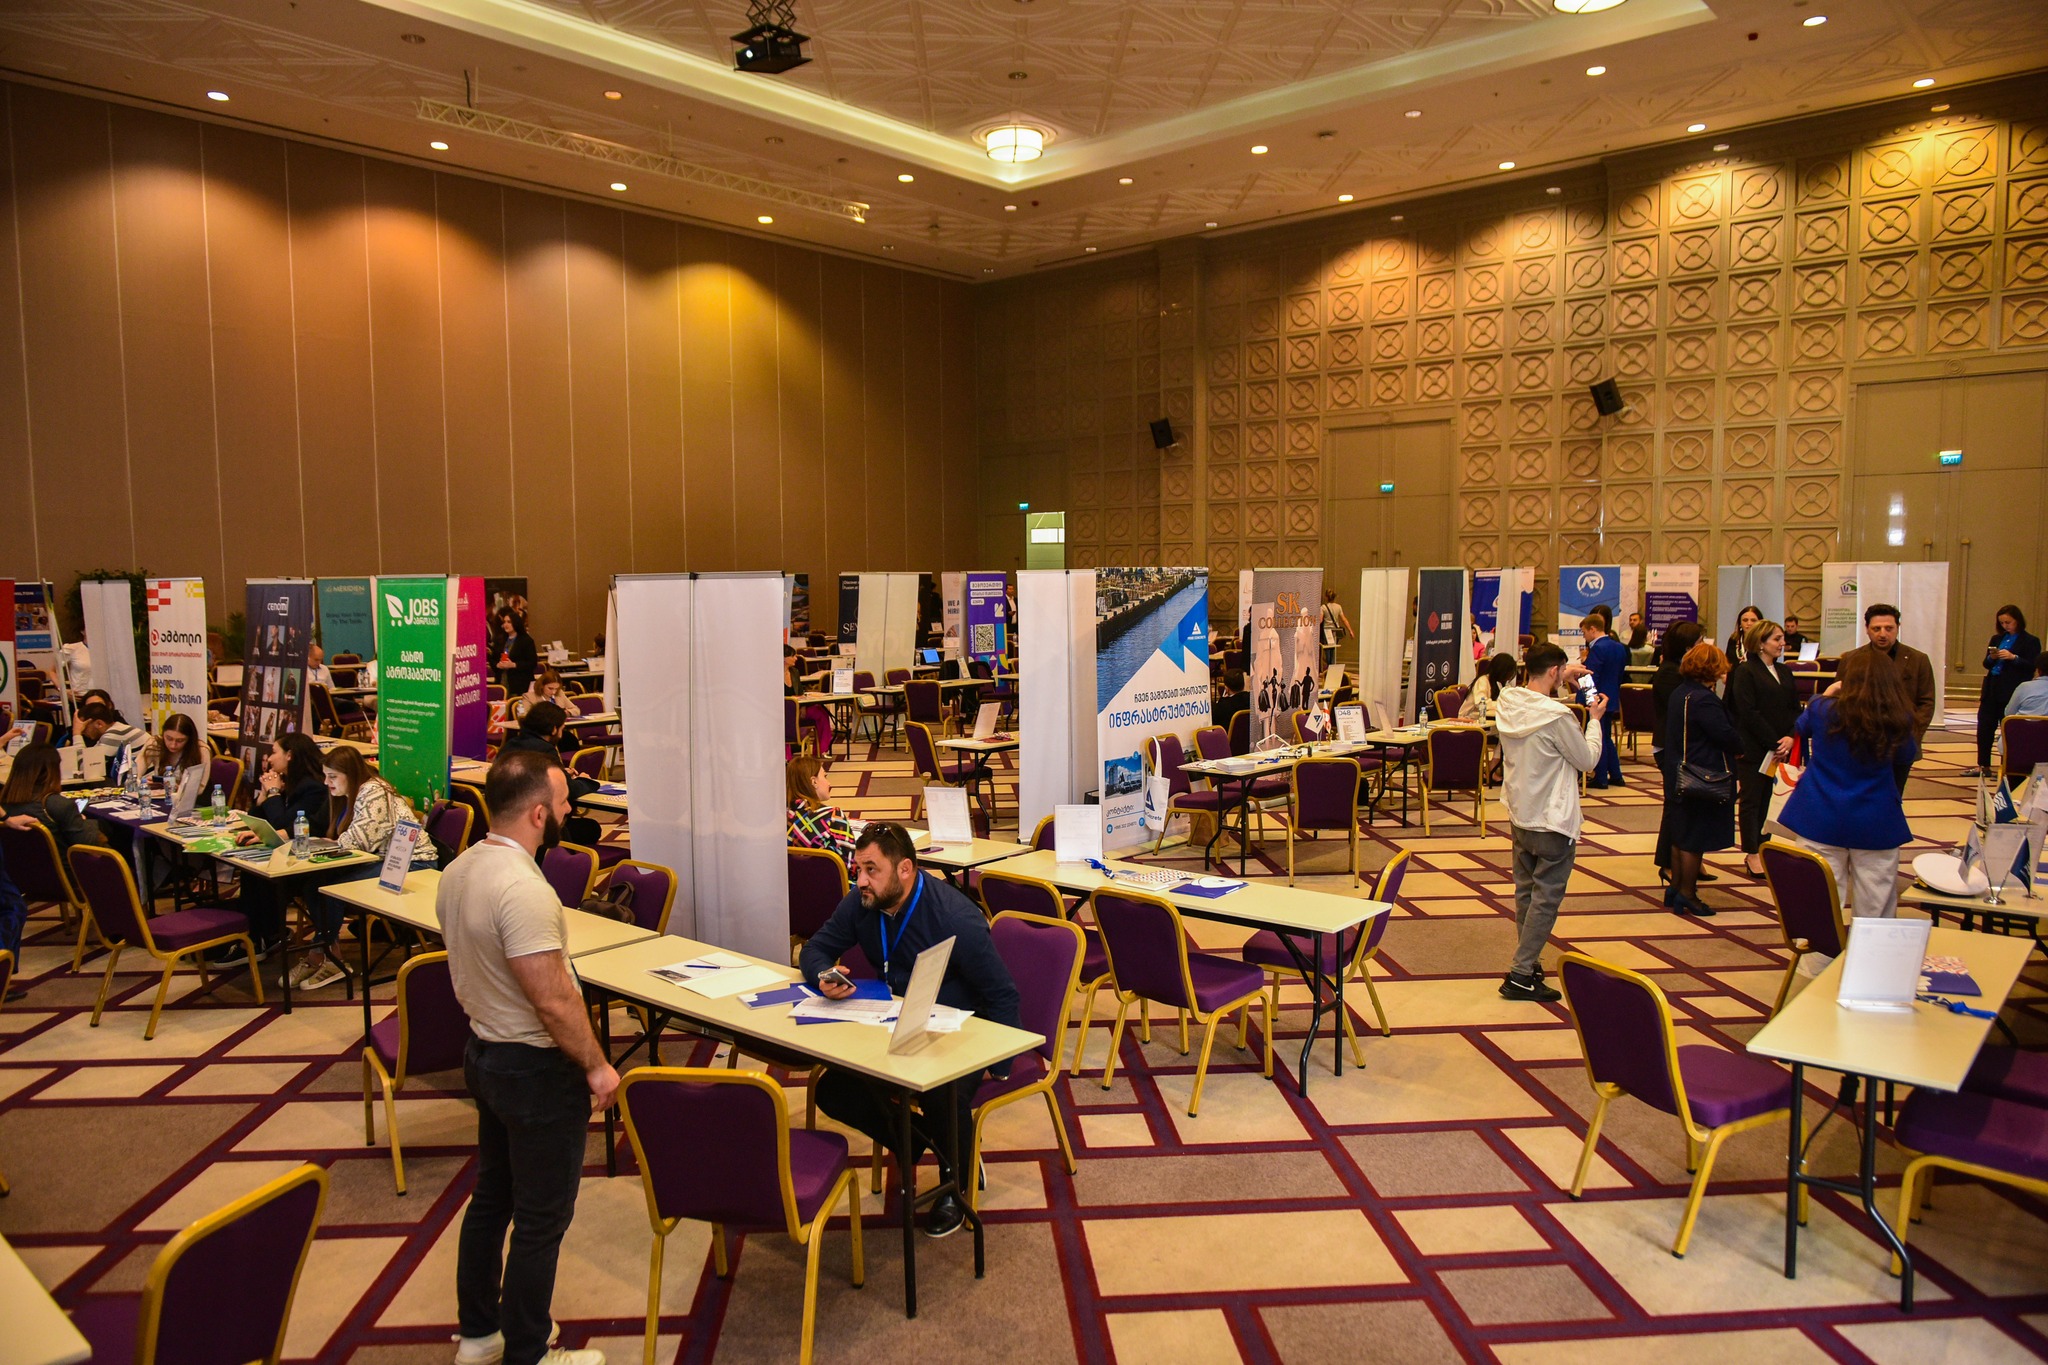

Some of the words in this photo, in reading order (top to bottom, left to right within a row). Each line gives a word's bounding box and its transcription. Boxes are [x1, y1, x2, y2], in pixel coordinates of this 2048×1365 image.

[1943, 456, 1958, 464] EXIT
[1276, 592, 1300, 614] SK
[404, 598, 439, 625] JOBS
[1258, 615, 1316, 629] COLLECTION
[401, 651, 424, 663] გახდი
[1134, 692, 1149, 703] ჩვენ
[1150, 688, 1178, 701] ვაშენებთ
[1109, 699, 1210, 729] ინფრასტრუქტურას
